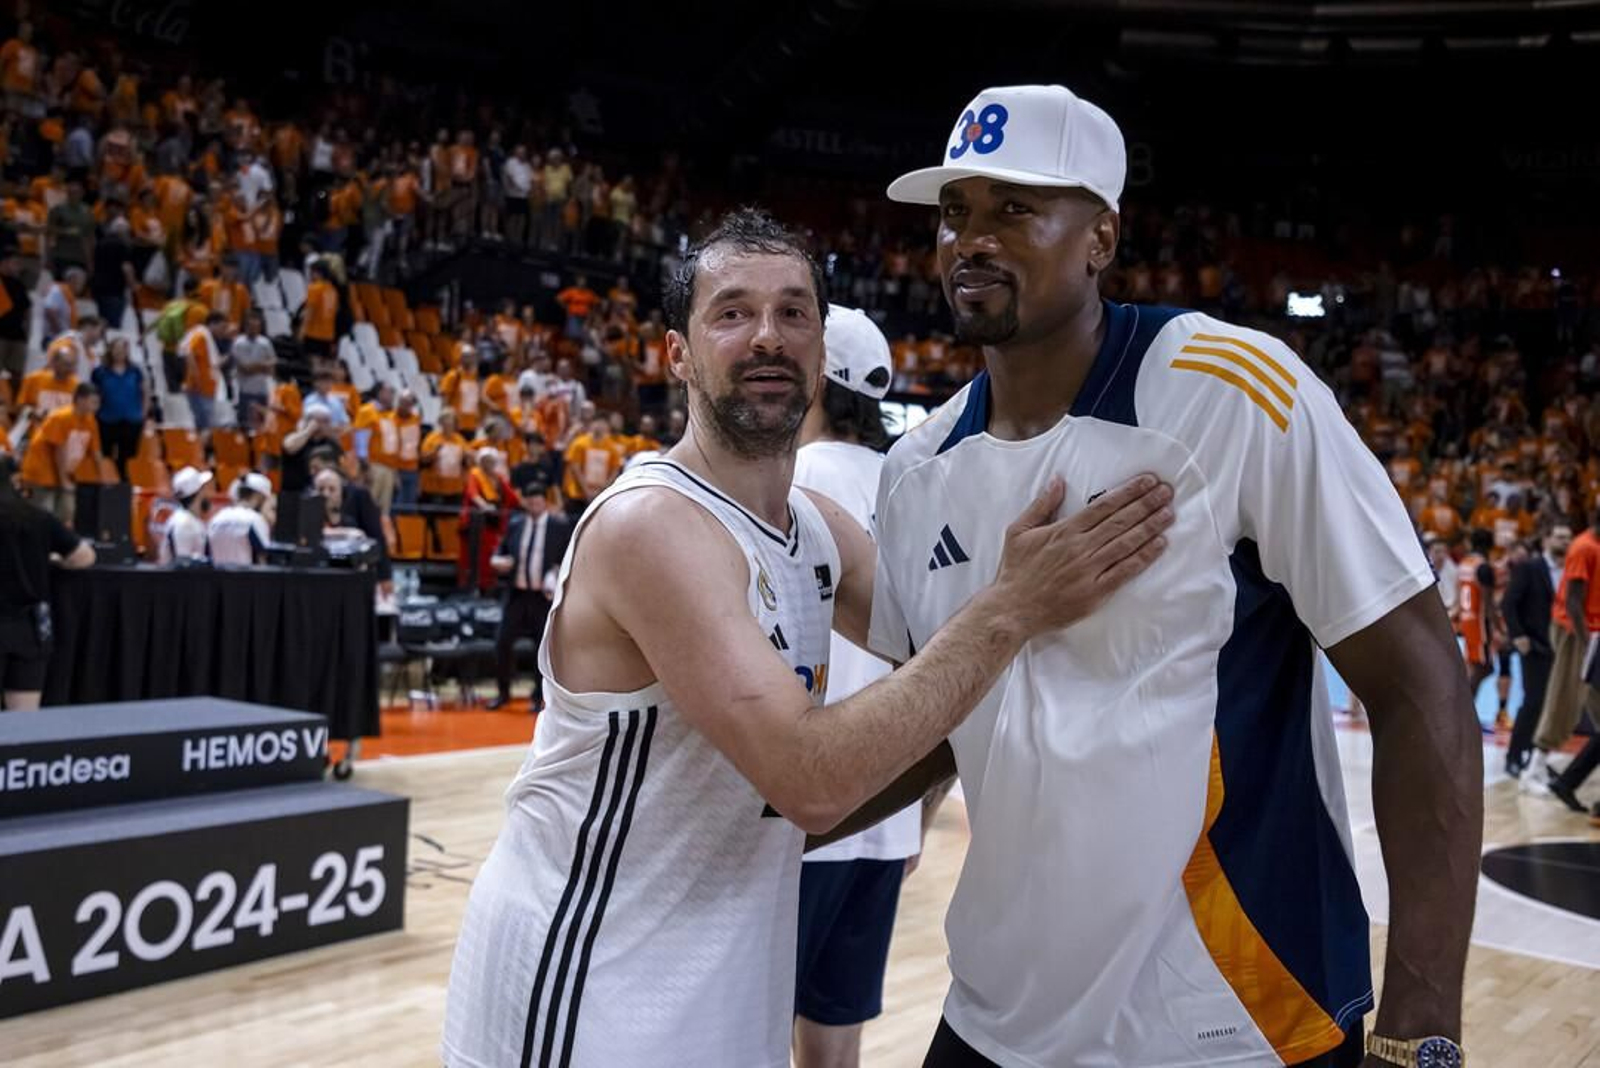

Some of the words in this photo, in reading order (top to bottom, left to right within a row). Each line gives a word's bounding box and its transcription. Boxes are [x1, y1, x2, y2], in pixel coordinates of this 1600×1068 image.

[949, 103, 1009, 159] 38
[182, 727, 298, 772] HEMOS
[71, 844, 387, 976] 2024-25
